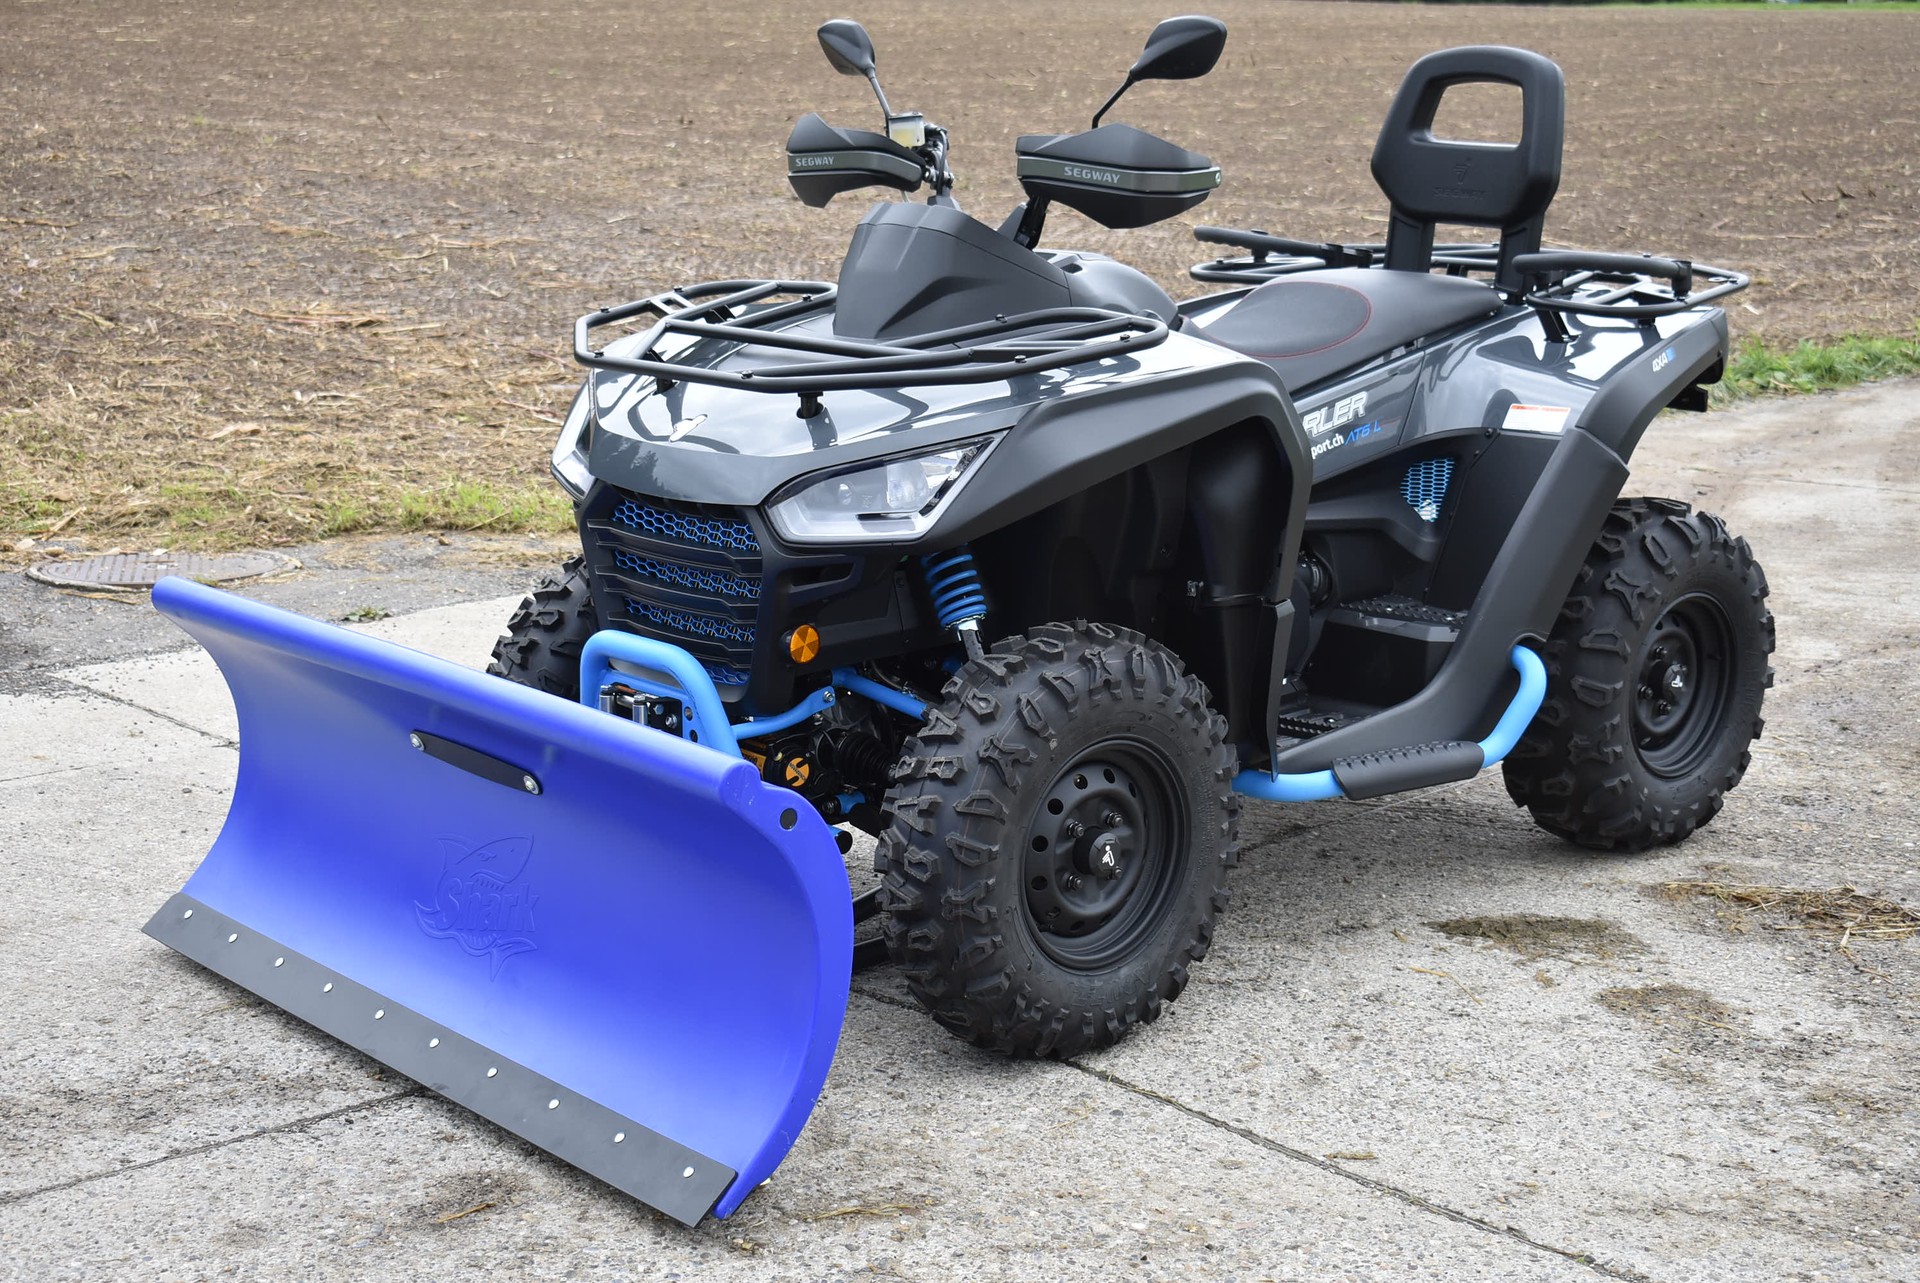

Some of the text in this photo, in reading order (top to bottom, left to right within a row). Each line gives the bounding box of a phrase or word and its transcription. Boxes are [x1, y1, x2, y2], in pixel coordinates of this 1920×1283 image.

[795, 156, 834, 167] SEGWAY
[1063, 166, 1121, 184] SEGWAY
[1344, 419, 1383, 446] AT6 L
[1310, 432, 1345, 460] port.ch
